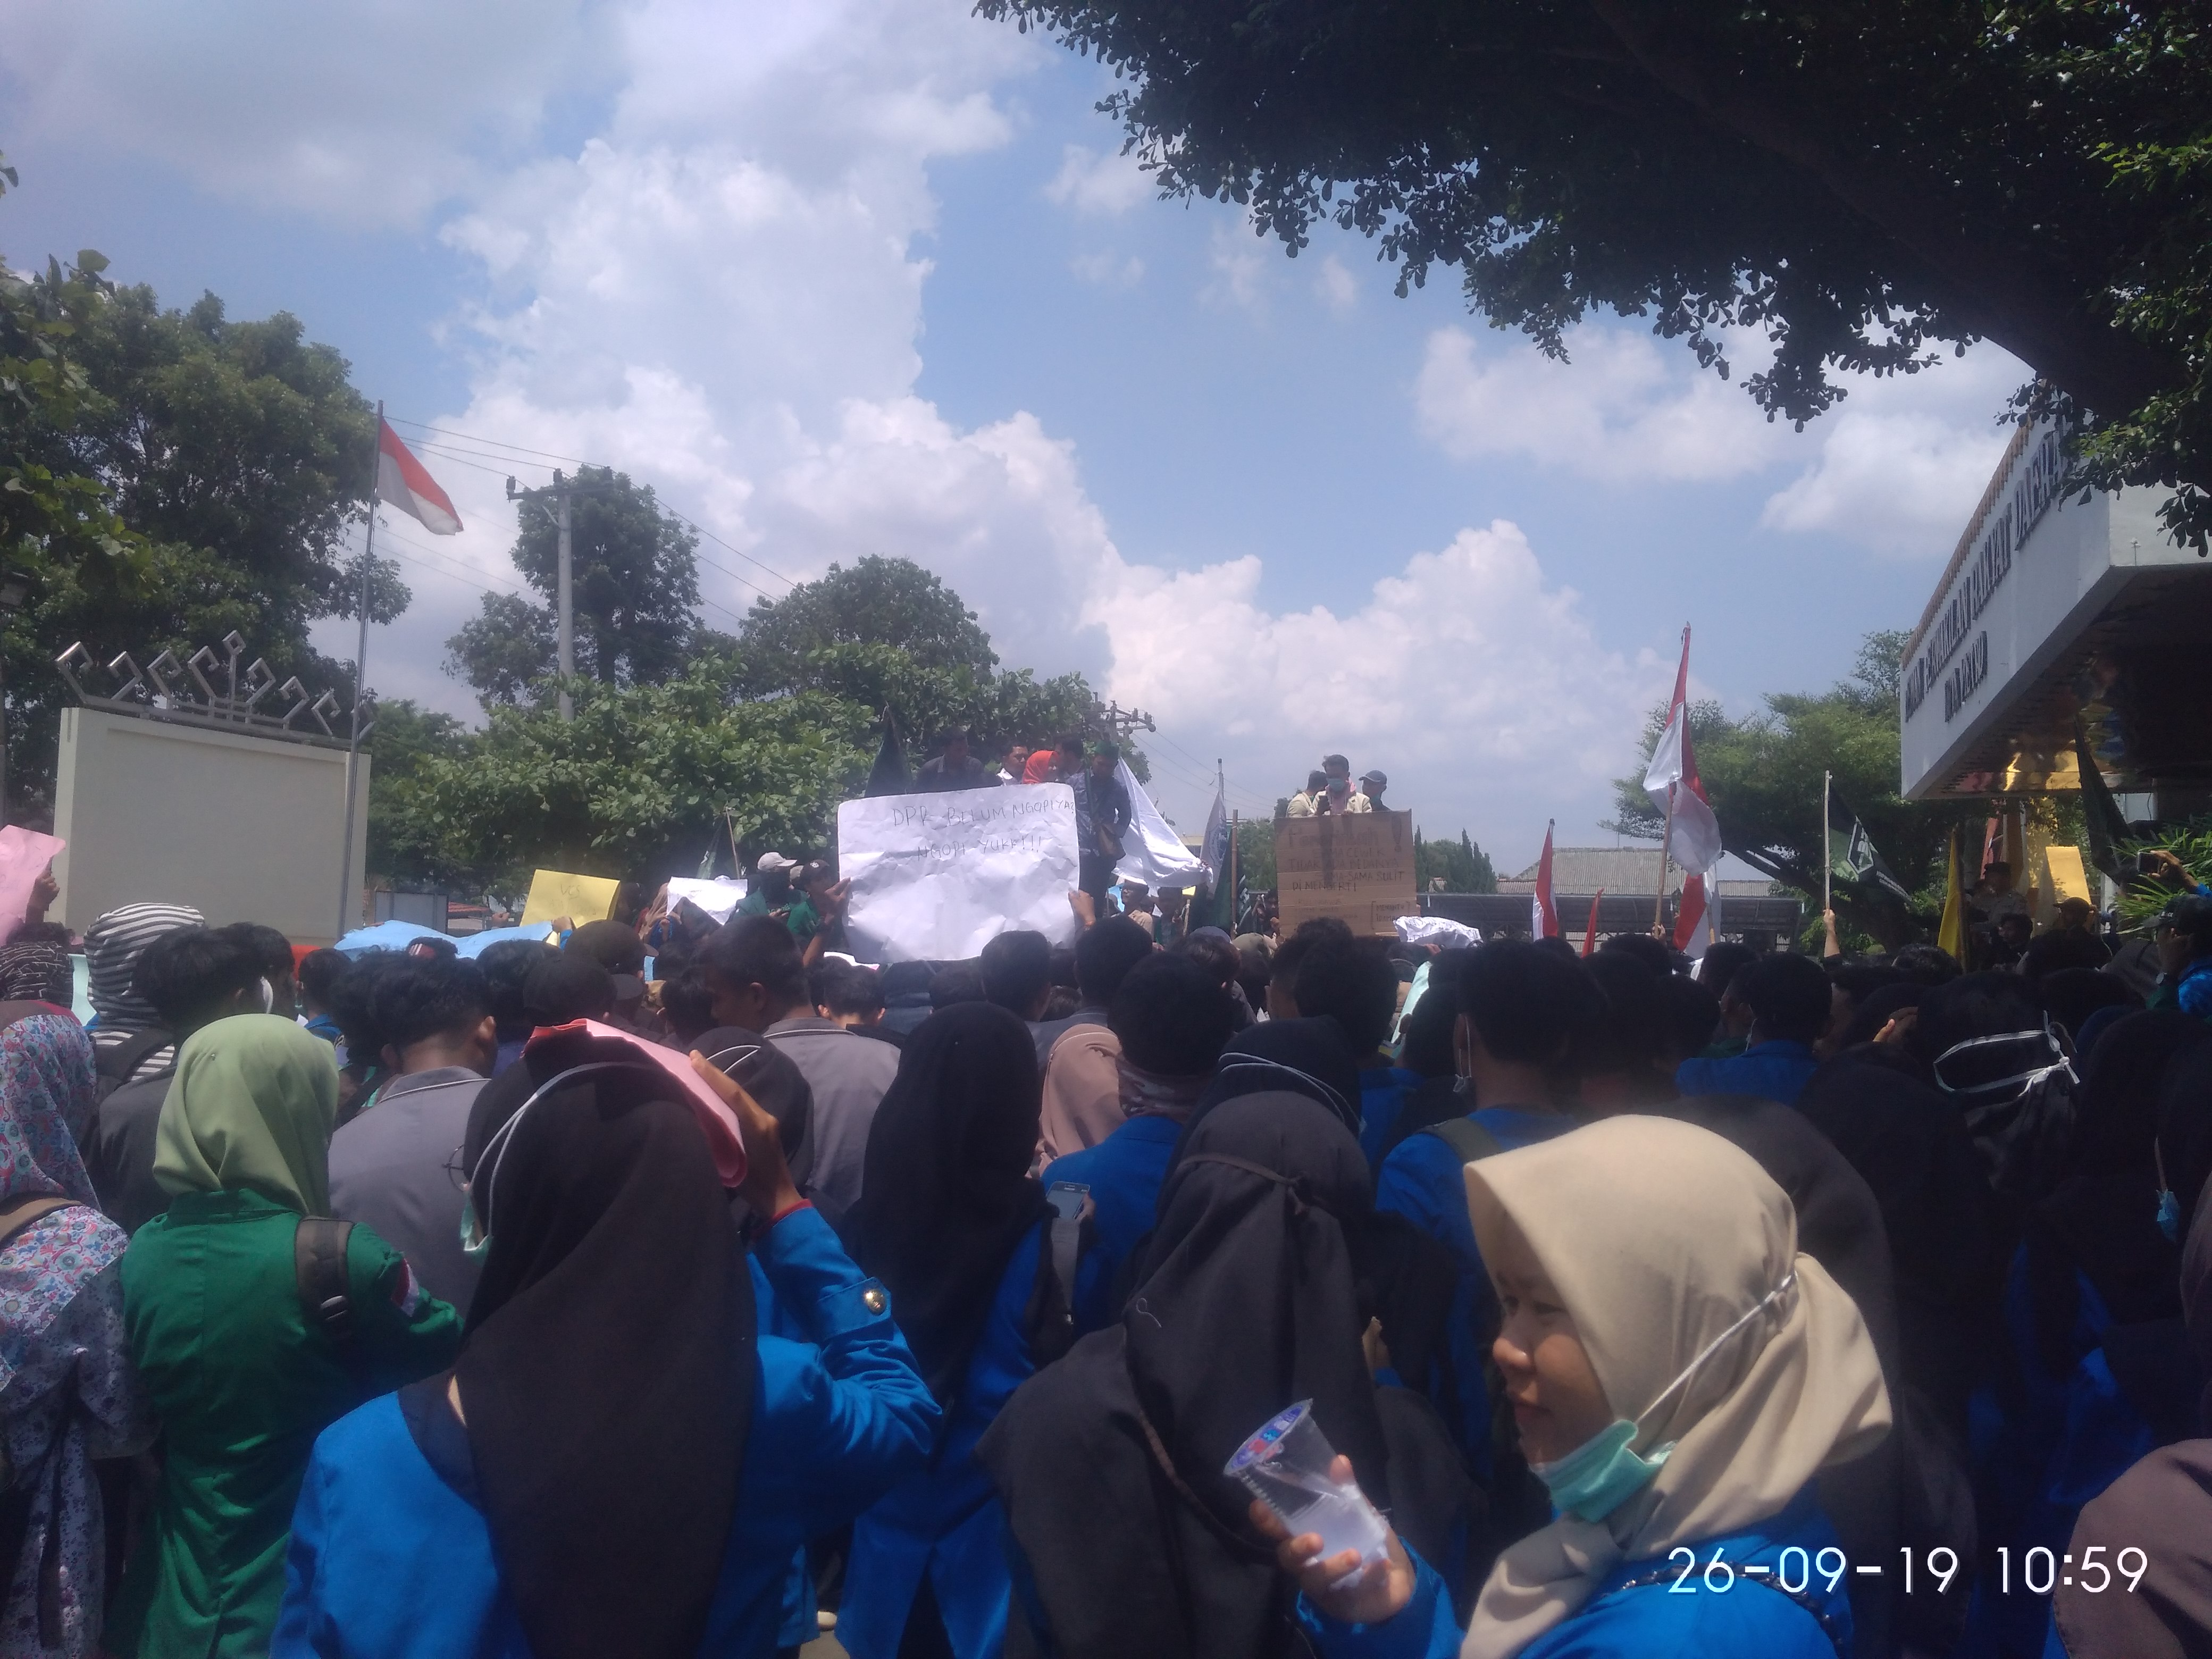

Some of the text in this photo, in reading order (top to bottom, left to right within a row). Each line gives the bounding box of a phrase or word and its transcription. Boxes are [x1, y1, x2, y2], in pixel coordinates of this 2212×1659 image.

[1971, 502, 2012, 620] RAKYAT
[892, 806, 932, 826] DPR
[948, 806, 1006, 826] BELUM
[1012, 799, 1054, 818] NGOPI
[917, 841, 966, 861] NGOPI
[1288, 858, 1321, 871] TIDAK
